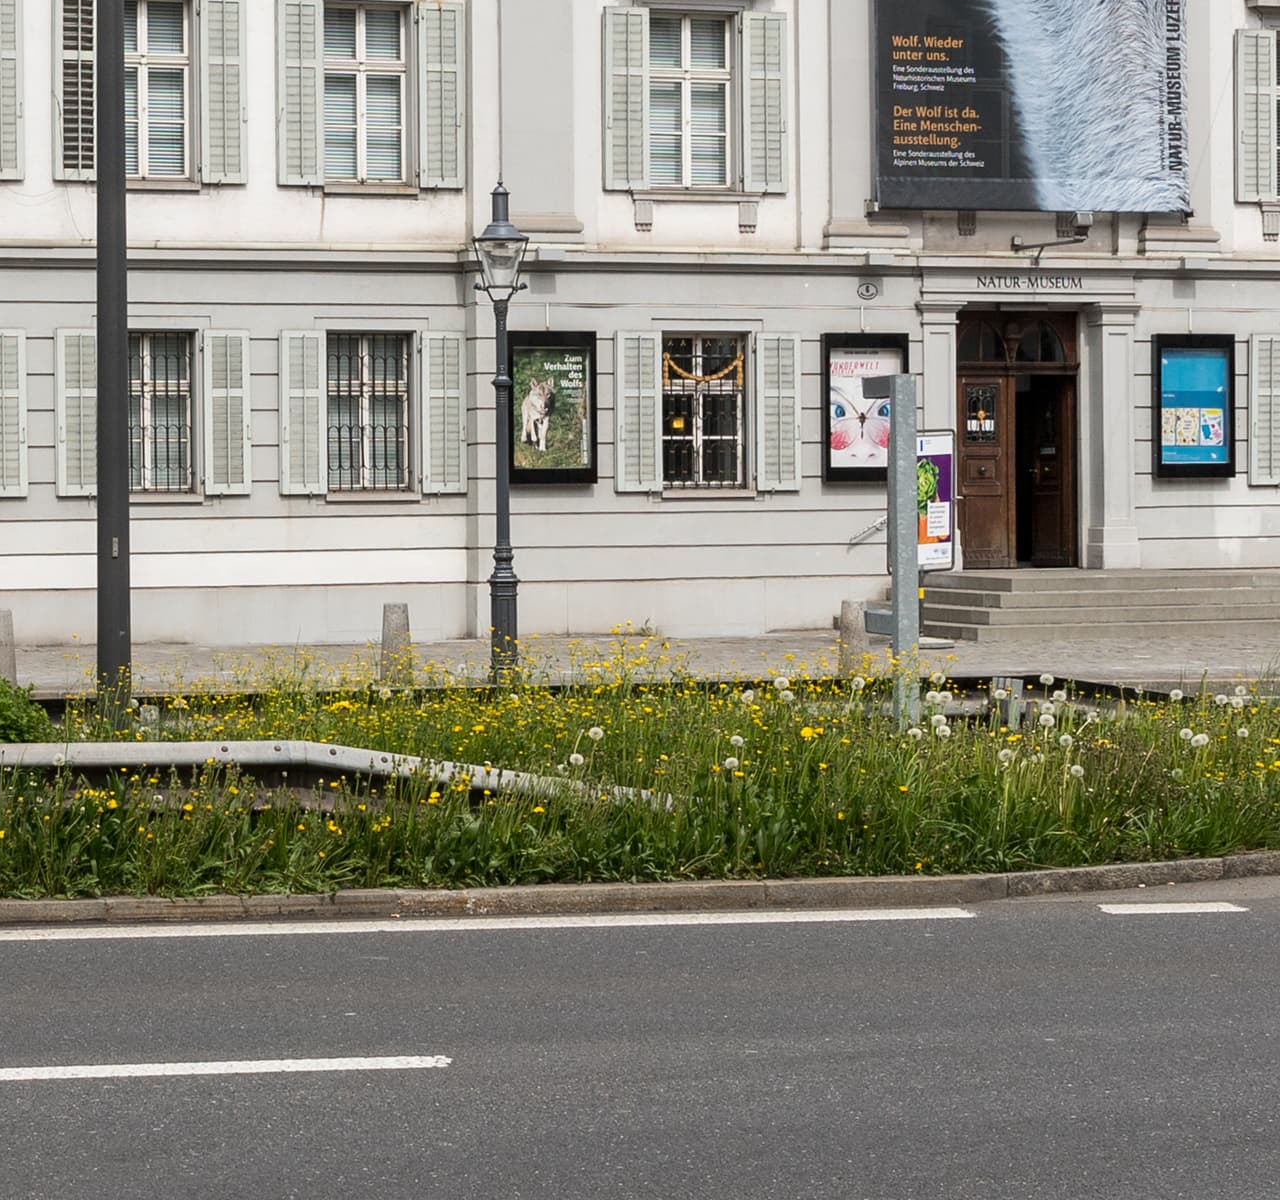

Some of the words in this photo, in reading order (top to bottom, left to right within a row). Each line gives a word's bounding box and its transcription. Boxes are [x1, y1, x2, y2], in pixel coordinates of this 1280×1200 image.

[892, 35, 921, 47] Wolf.
[924, 36, 964, 48] Wieder
[893, 51, 924, 60] unter
[926, 52, 950, 61] uns.
[892, 65, 905, 73] Eine
[906, 65, 962, 75] Sonderausstellung
[963, 66, 974, 74] des
[893, 74, 945, 82] Naturhistorischen
[946, 75, 976, 83] Museums
[920, 83, 945, 91] Schweiz
[893, 105, 913, 117] Der
[915, 106, 942, 117] Wolf
[944, 106, 958, 118] ist
[961, 107, 980, 118] da.
[1166, 47, 1183, 172] NATUR-MUSEUM
[893, 120, 917, 131] Eine
[920, 120, 982, 132] Menschen-
[893, 134, 961, 149] ausstellung.
[893, 149, 907, 157] Eine
[908, 150, 963, 160] Sonderausstellung
[893, 159, 917, 167] Alpinen
[918, 159, 947, 167] Museums
[959, 160, 985, 168] Schweiz
[977, 276, 1083, 289] NATUR-MUSEUM
[565, 354, 582, 362] Zum
[544, 362, 583, 371] Verhalten
[568, 370, 583, 379] des
[560, 379, 583, 388] Wolfs
